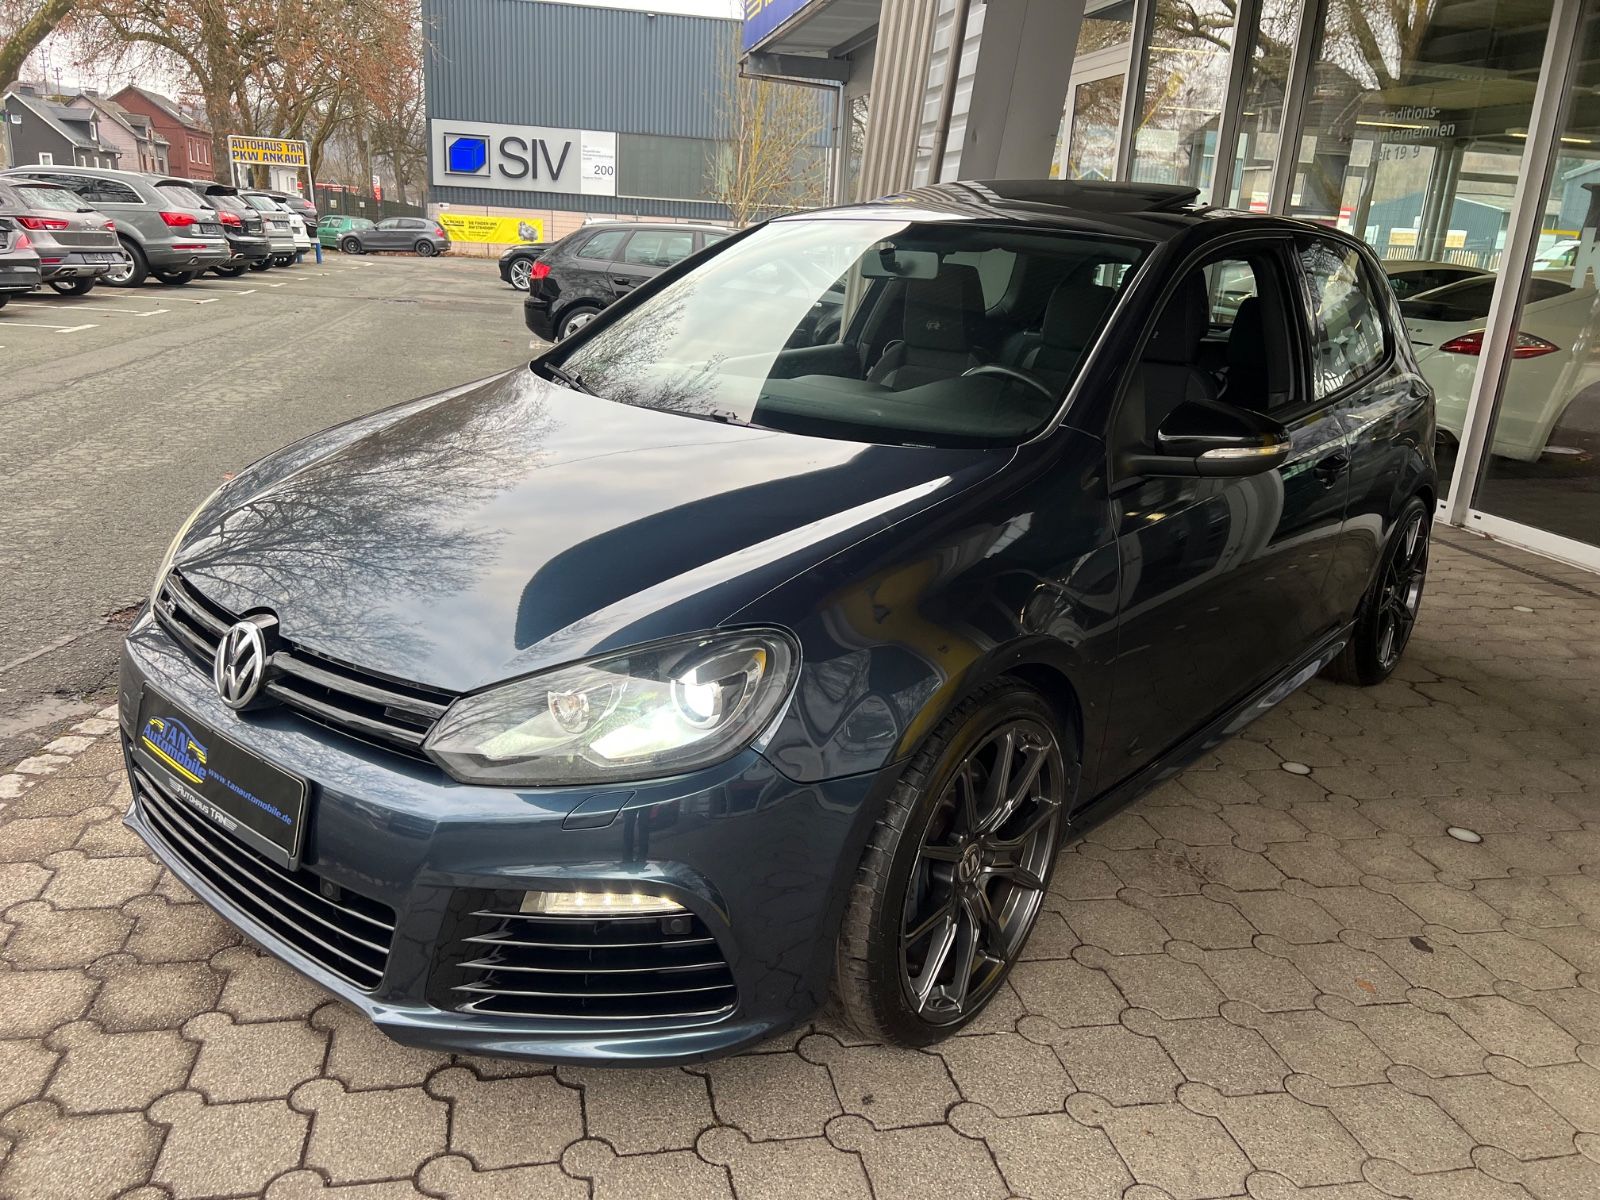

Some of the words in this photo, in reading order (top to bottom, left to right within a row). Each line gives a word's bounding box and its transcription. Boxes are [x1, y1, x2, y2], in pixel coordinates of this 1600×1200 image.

[1378, 106, 1440, 119] Traditions-
[232, 139, 283, 152] AUTOHAUS
[285, 143, 303, 154] TAN
[232, 150, 259, 161] PKW
[262, 152, 304, 165] ANKAUF
[498, 136, 572, 181] SIV
[594, 164, 614, 176] 200
[161, 720, 191, 754] TAN
[142, 723, 207, 780] Automobile
[208, 768, 293, 825] www.tanautomobile.de
[210, 807, 227, 826] TAN
